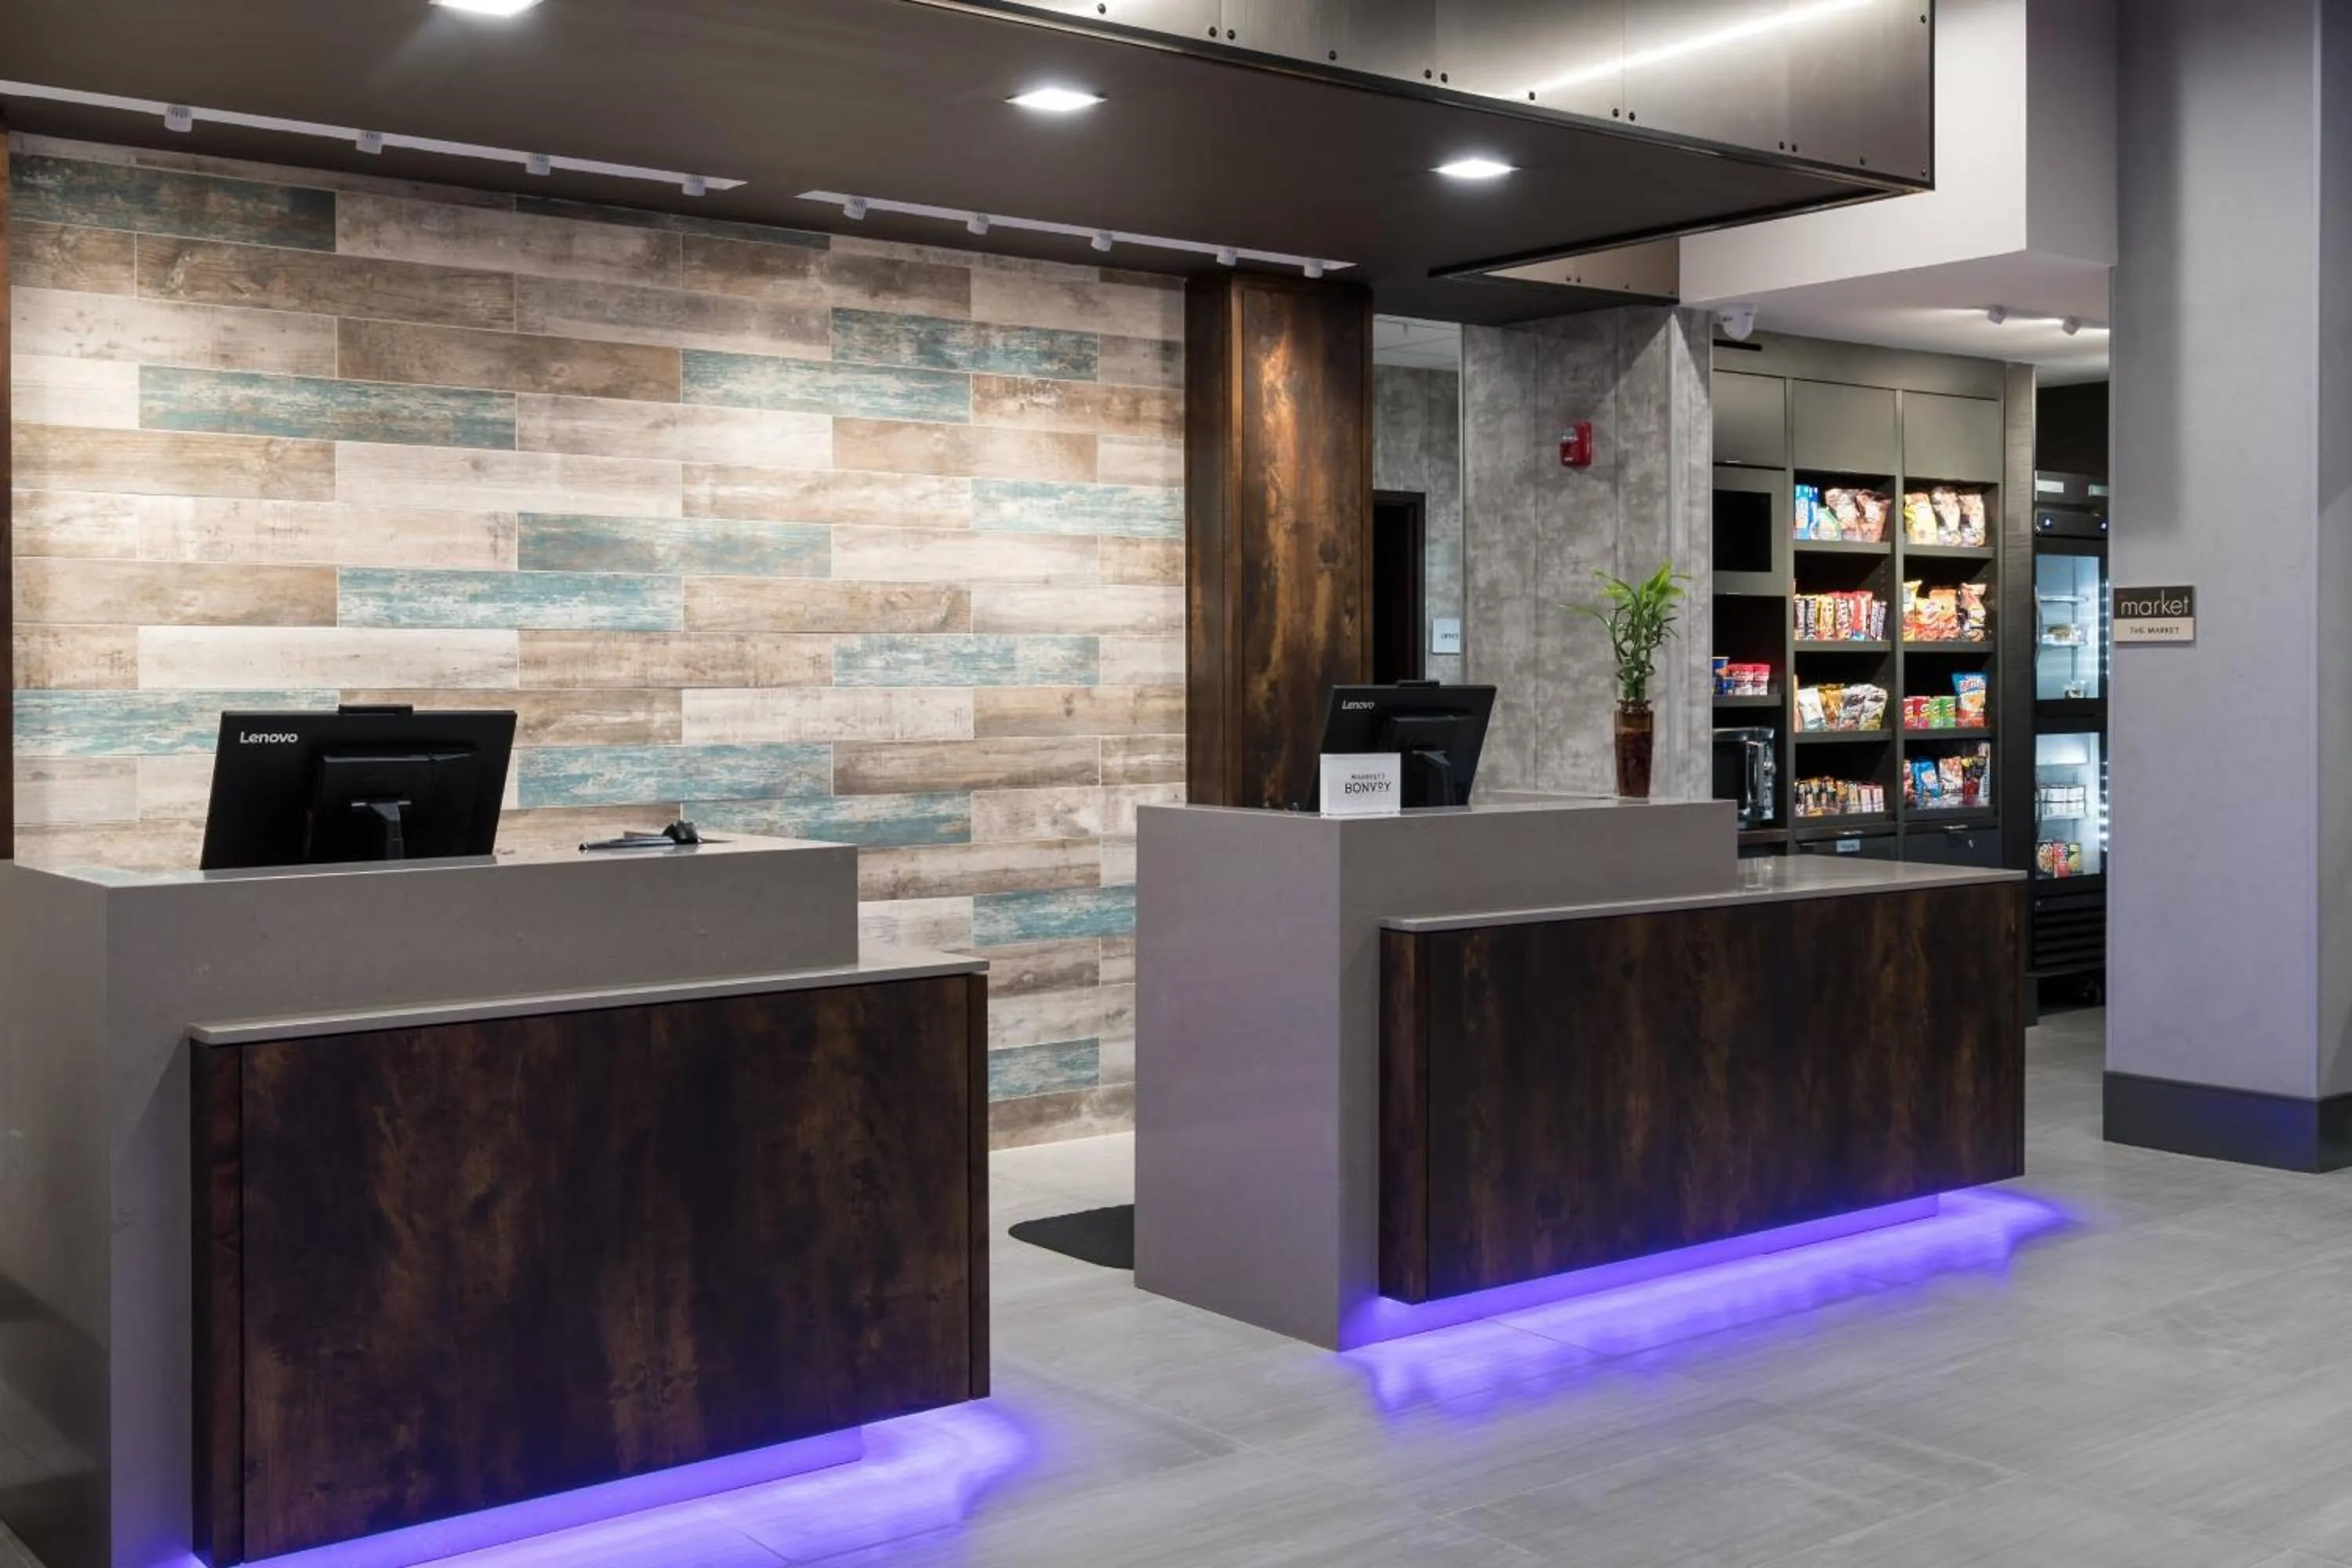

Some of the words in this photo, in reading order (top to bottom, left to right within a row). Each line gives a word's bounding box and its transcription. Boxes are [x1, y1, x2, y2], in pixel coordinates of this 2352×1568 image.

[2120, 590, 2189, 615] market
[1341, 699, 1375, 710] Lenovo
[239, 730, 299, 744] Lenovo
[1345, 781, 1392, 794] BONVOY
